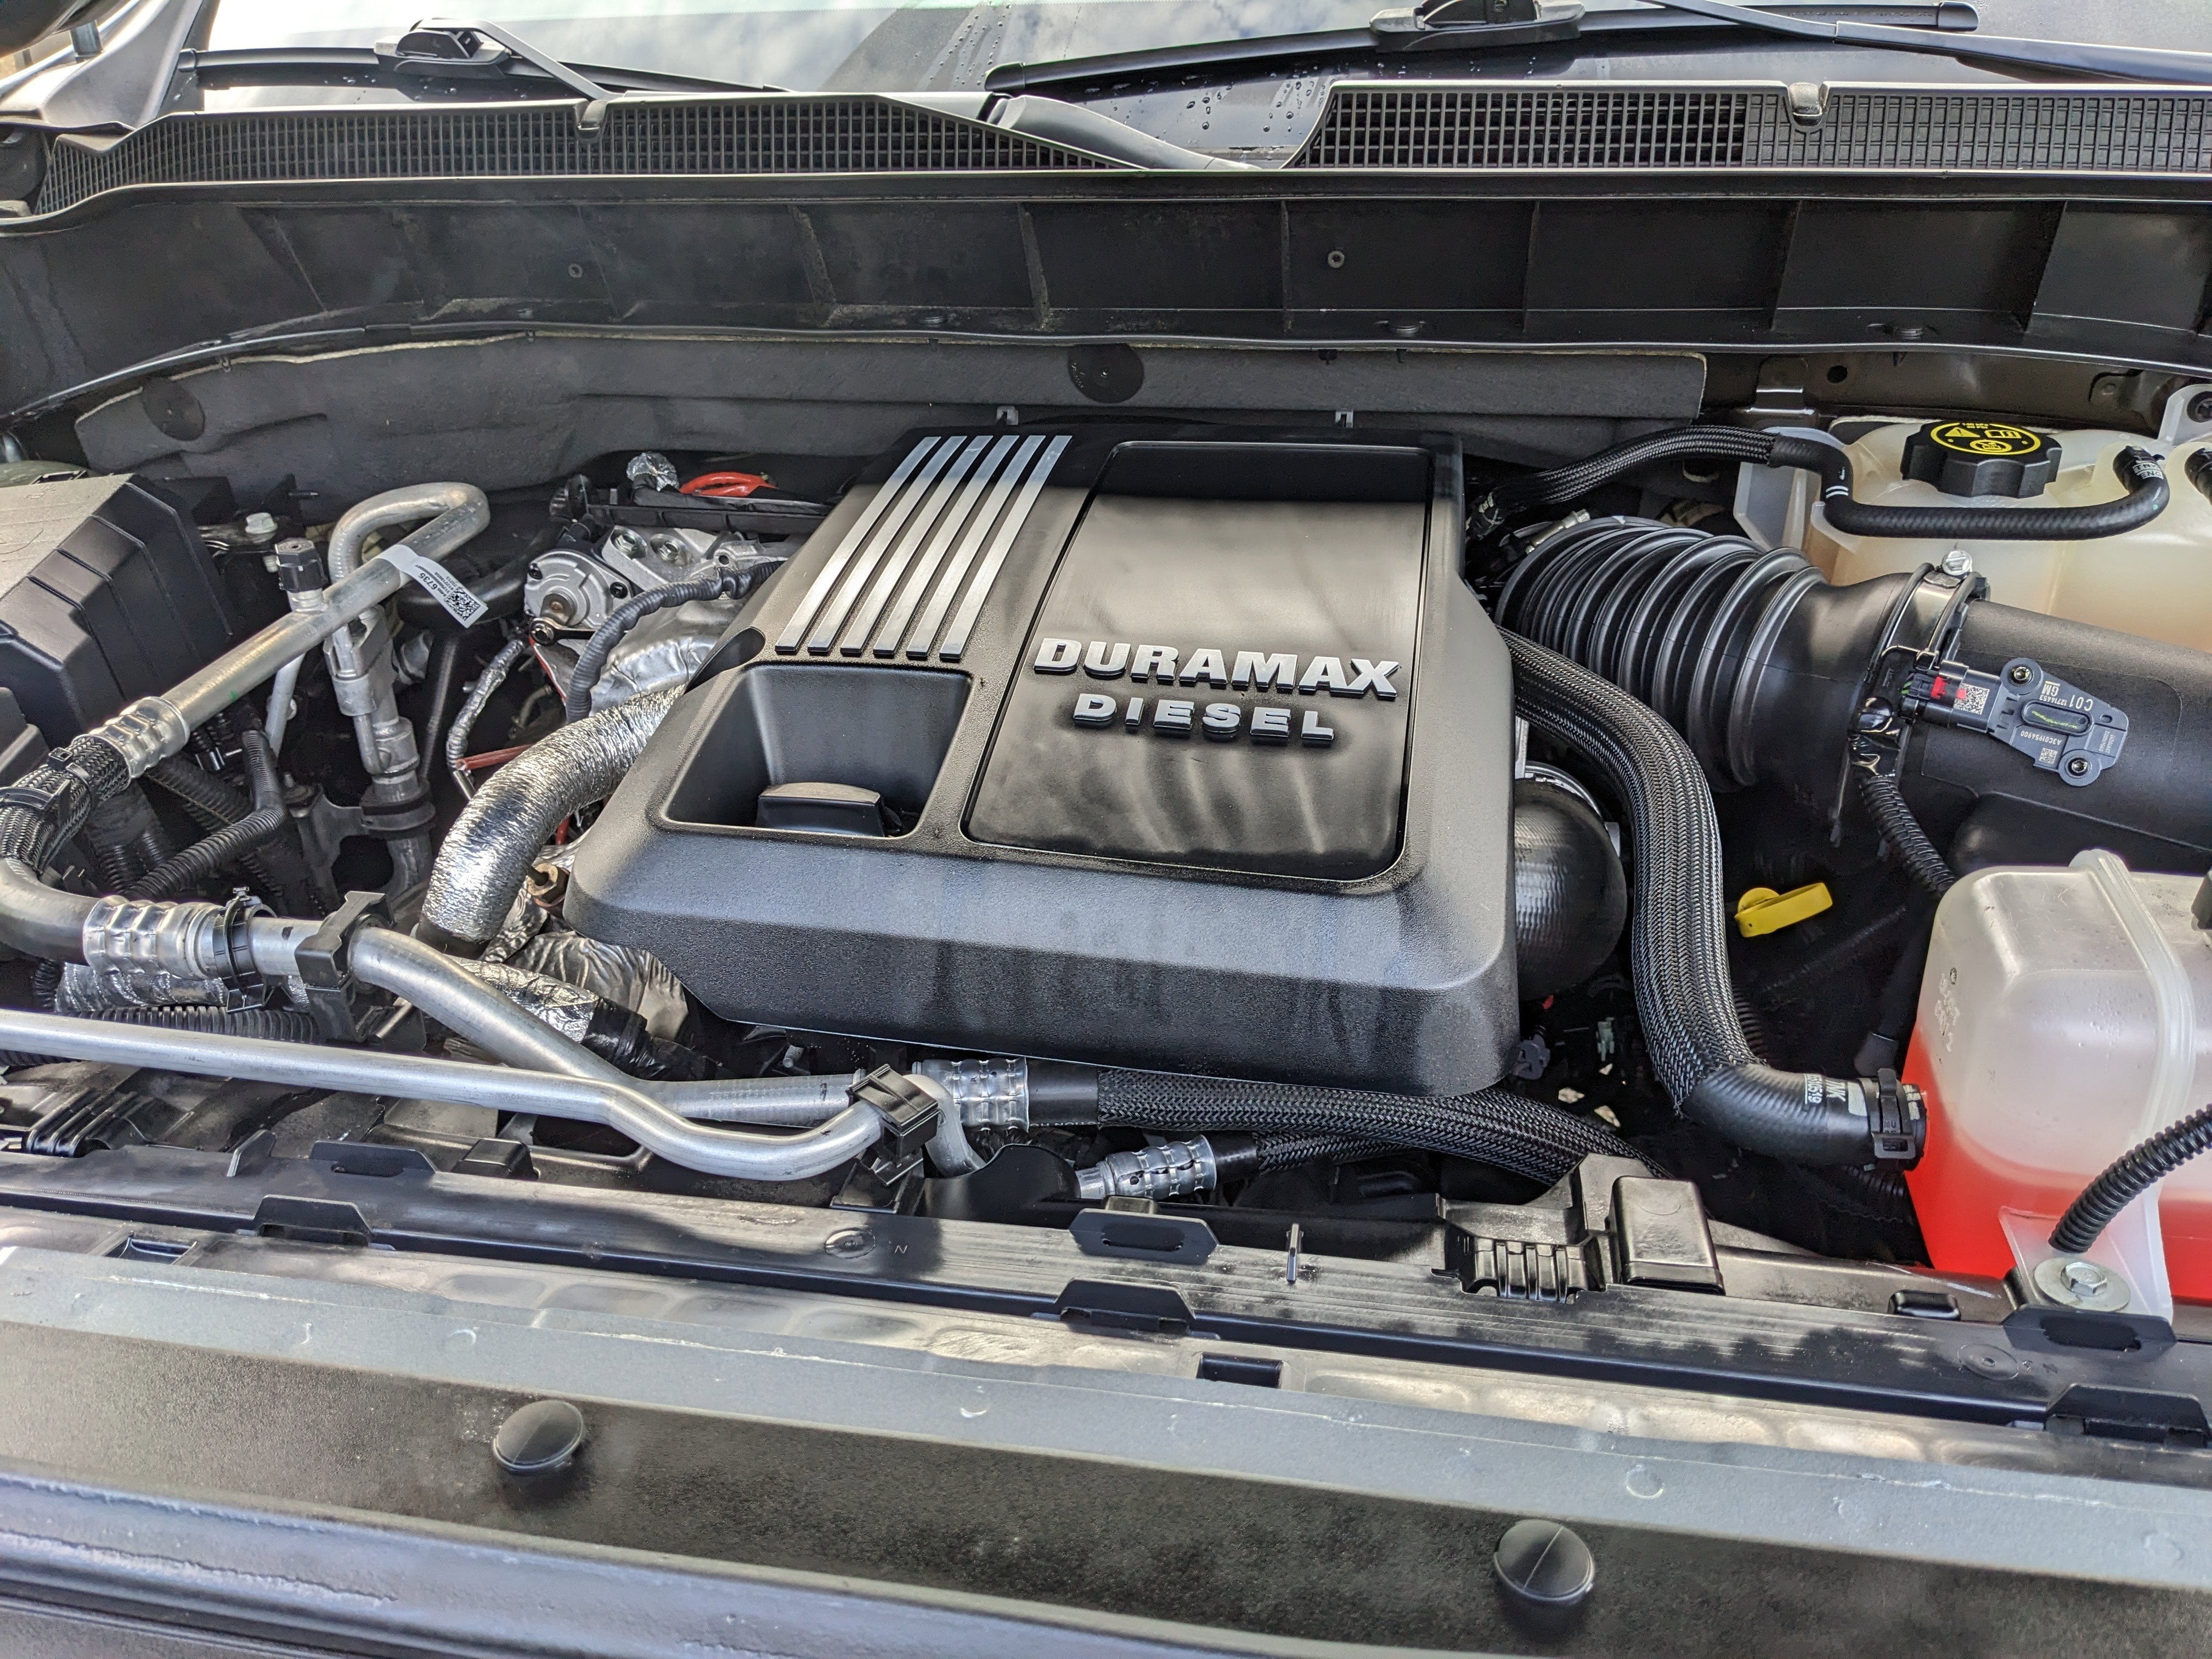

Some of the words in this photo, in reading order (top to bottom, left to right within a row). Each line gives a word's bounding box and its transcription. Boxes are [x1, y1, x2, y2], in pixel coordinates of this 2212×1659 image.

[419, 572, 438, 590] 6735
[1034, 637, 1401, 699] DURAMAX
[2041, 682, 2060, 697] GM
[2039, 694, 2068, 707] 12714453
[2069, 695, 2094, 712] C01
[1073, 693, 1334, 741] DIESEL
[2020, 730, 2062, 746] A3C01954900
